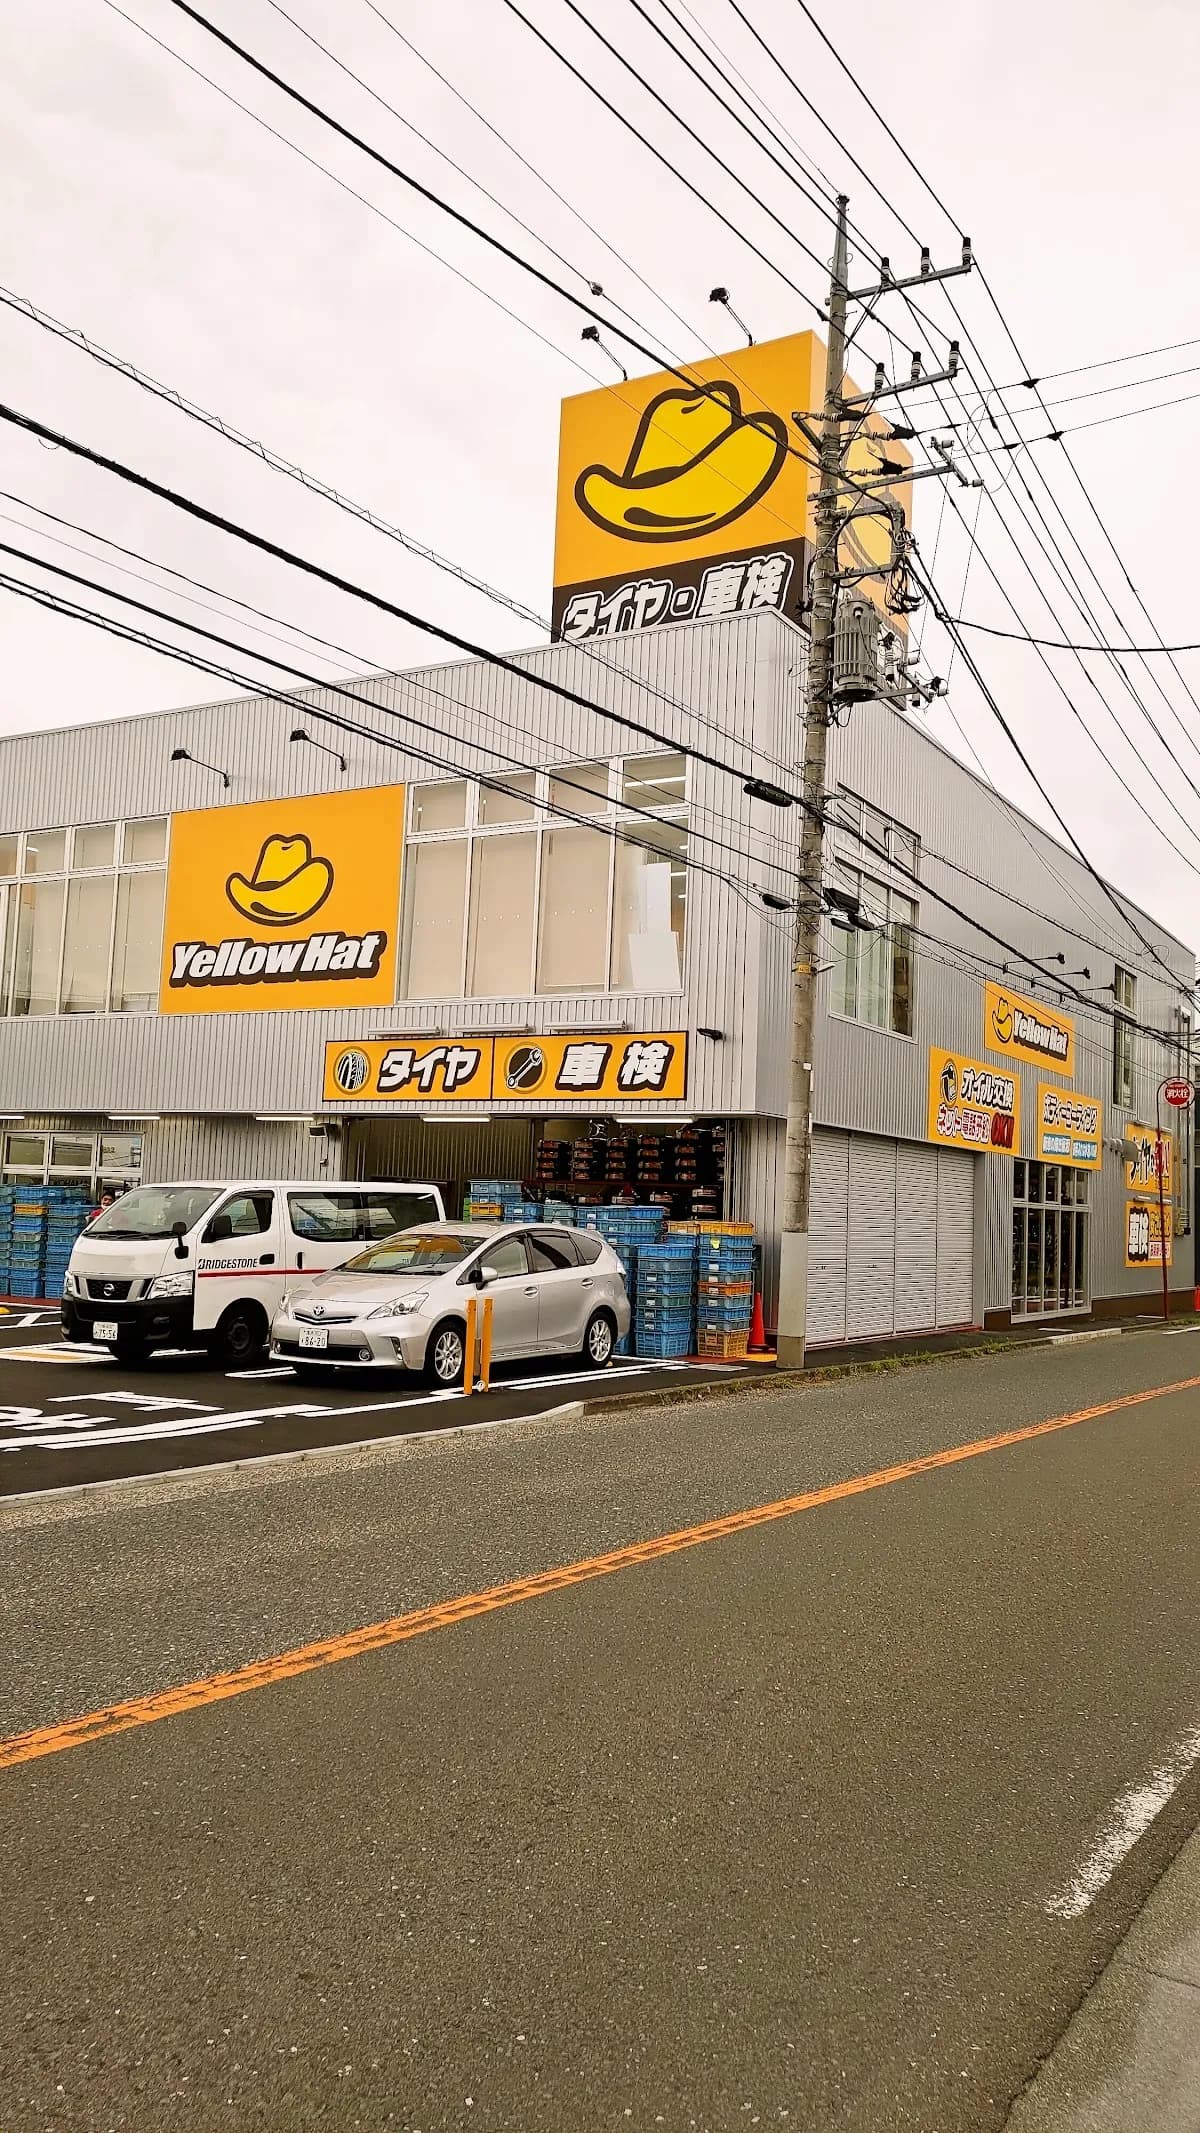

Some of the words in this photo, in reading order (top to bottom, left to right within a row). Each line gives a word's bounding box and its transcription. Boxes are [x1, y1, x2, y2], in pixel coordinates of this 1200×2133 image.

[377, 1045, 483, 1090] タイヤ
[556, 1042, 672, 1089] 車検
[961, 1069, 1014, 1110] オイル交換
[1166, 1088, 1189, 1099] 消火栓
[1044, 1092, 1098, 1134] ボディーコーティング
[1129, 1208, 1149, 1260] 車検
[197, 1258, 259, 1270] BRIDGESTONE
